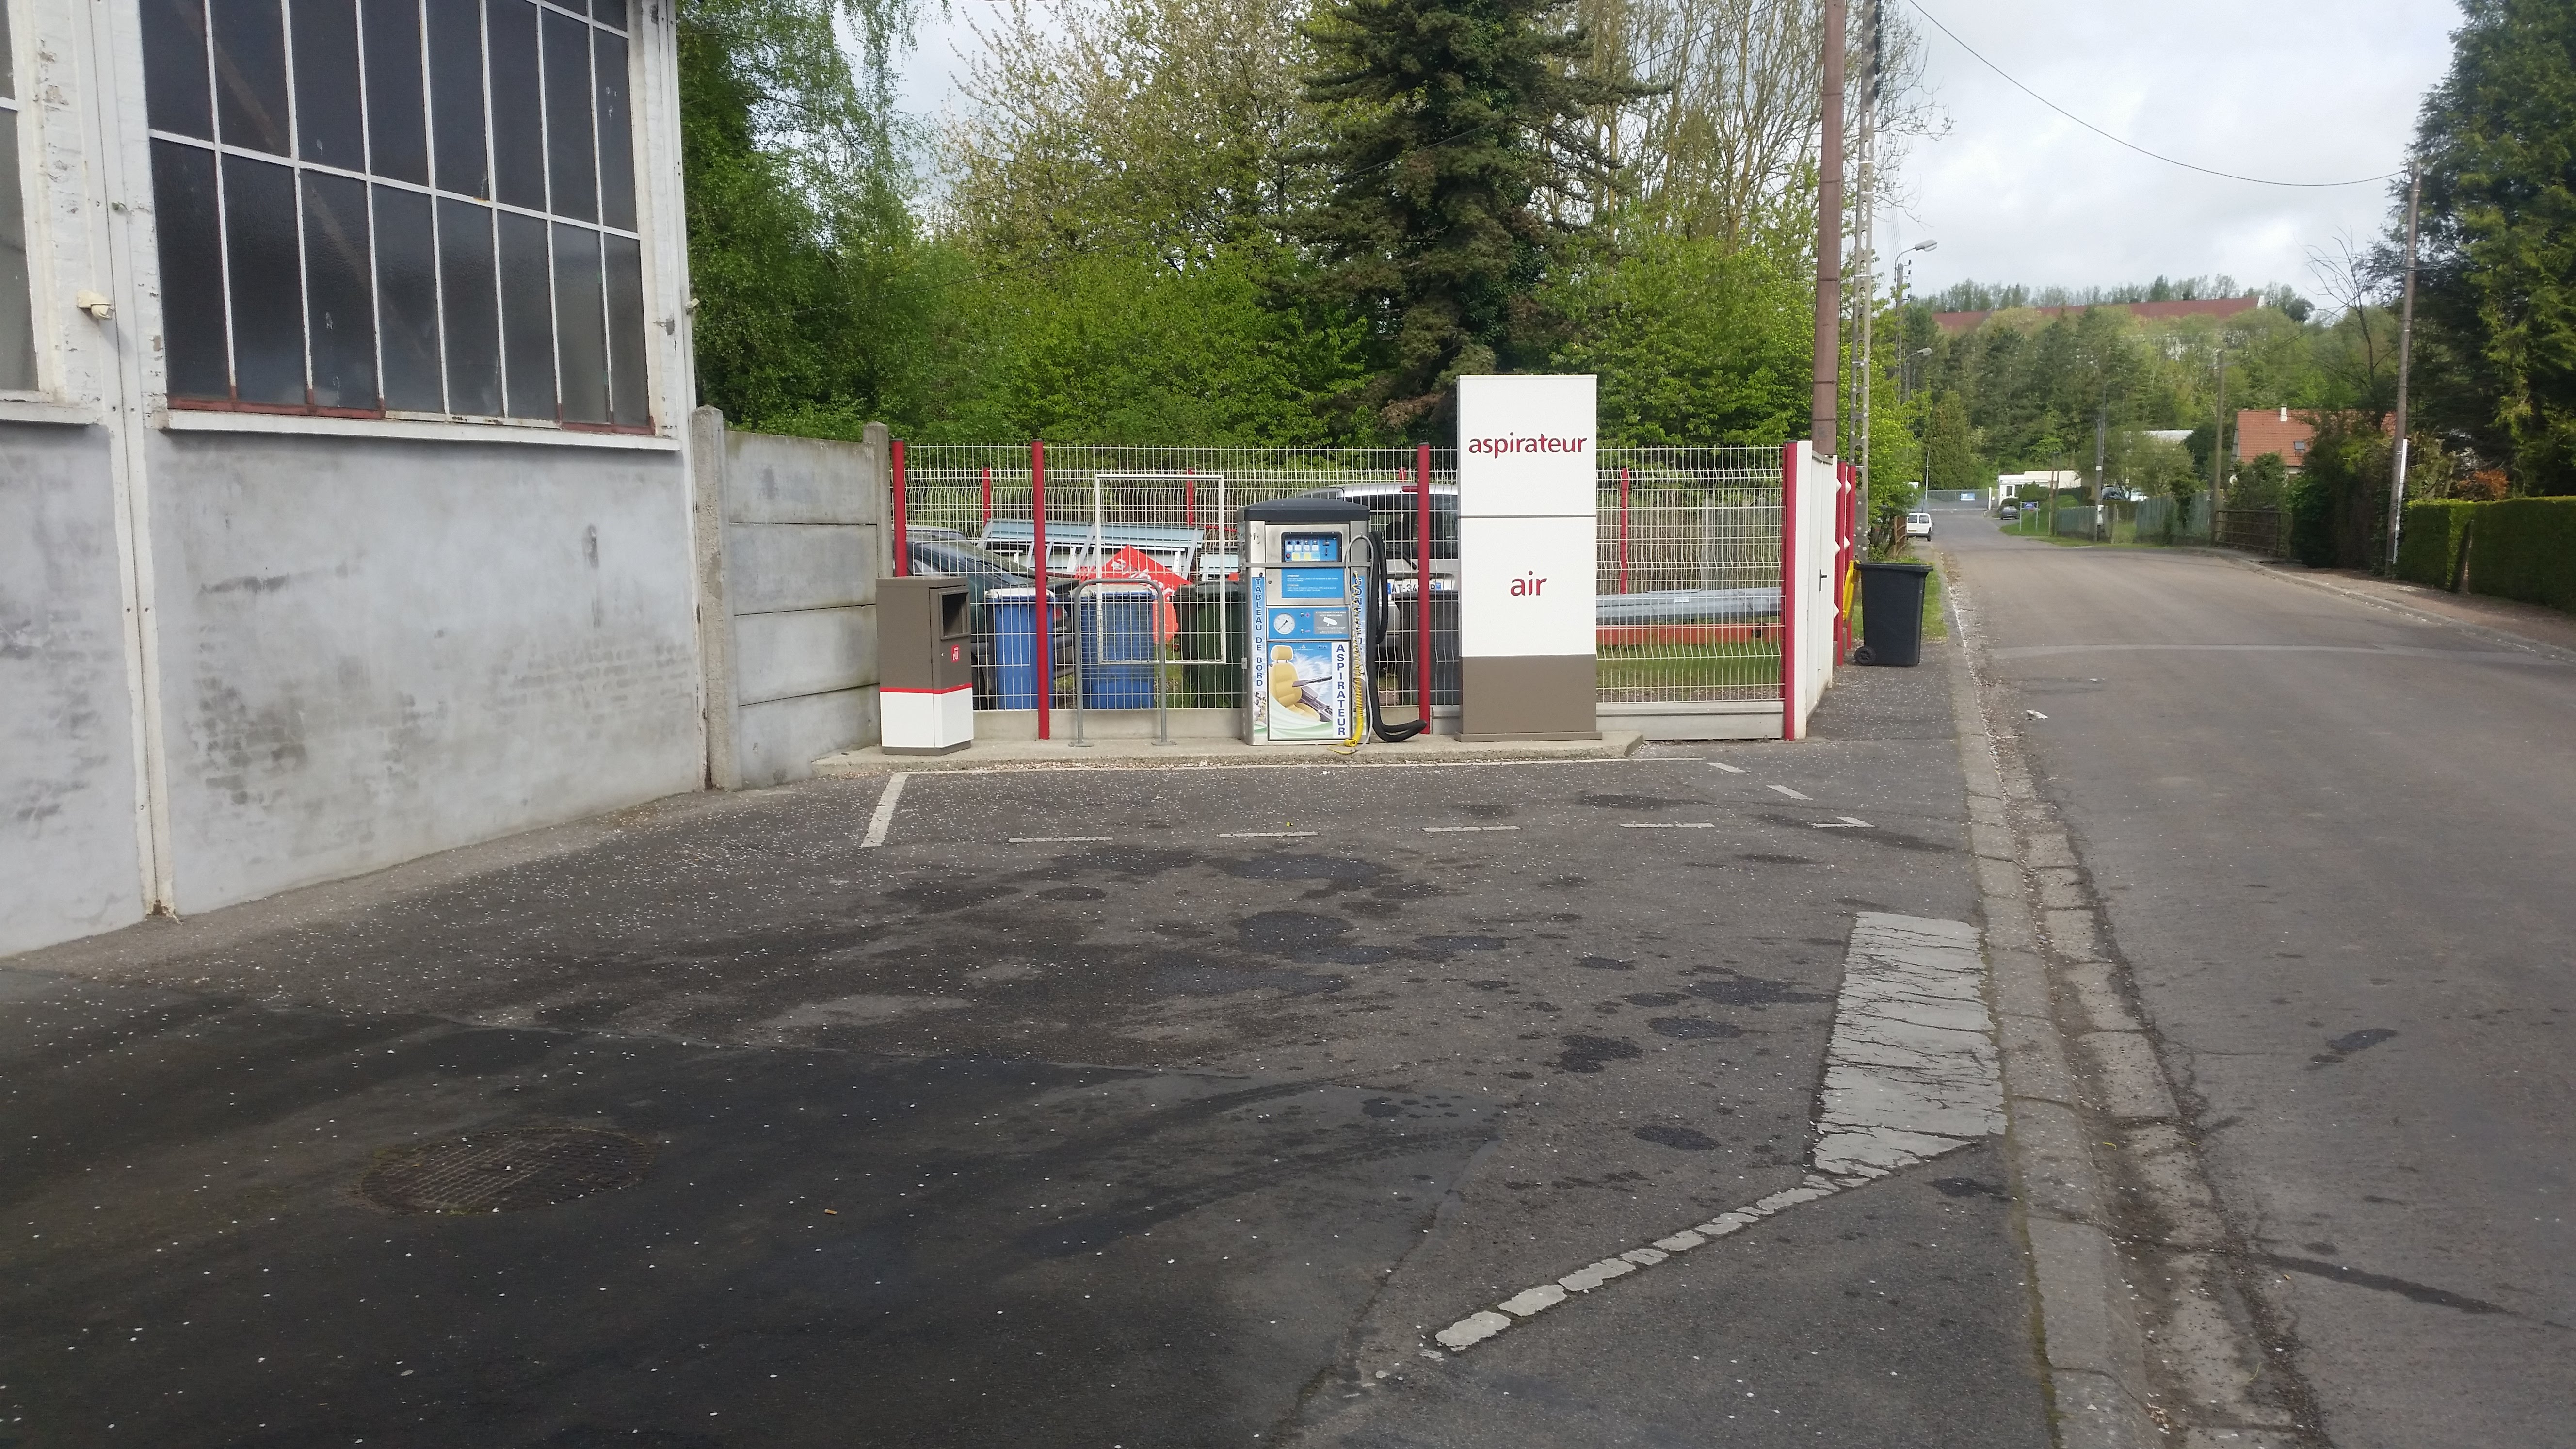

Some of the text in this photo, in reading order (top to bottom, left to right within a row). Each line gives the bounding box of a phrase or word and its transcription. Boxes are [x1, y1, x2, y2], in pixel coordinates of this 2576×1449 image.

[1468, 432, 1587, 459] aspirateur
[1510, 570, 1547, 596] air
[1256, 637, 1263, 651] DE
[1336, 644, 1346, 735] ASPIRATEUR
